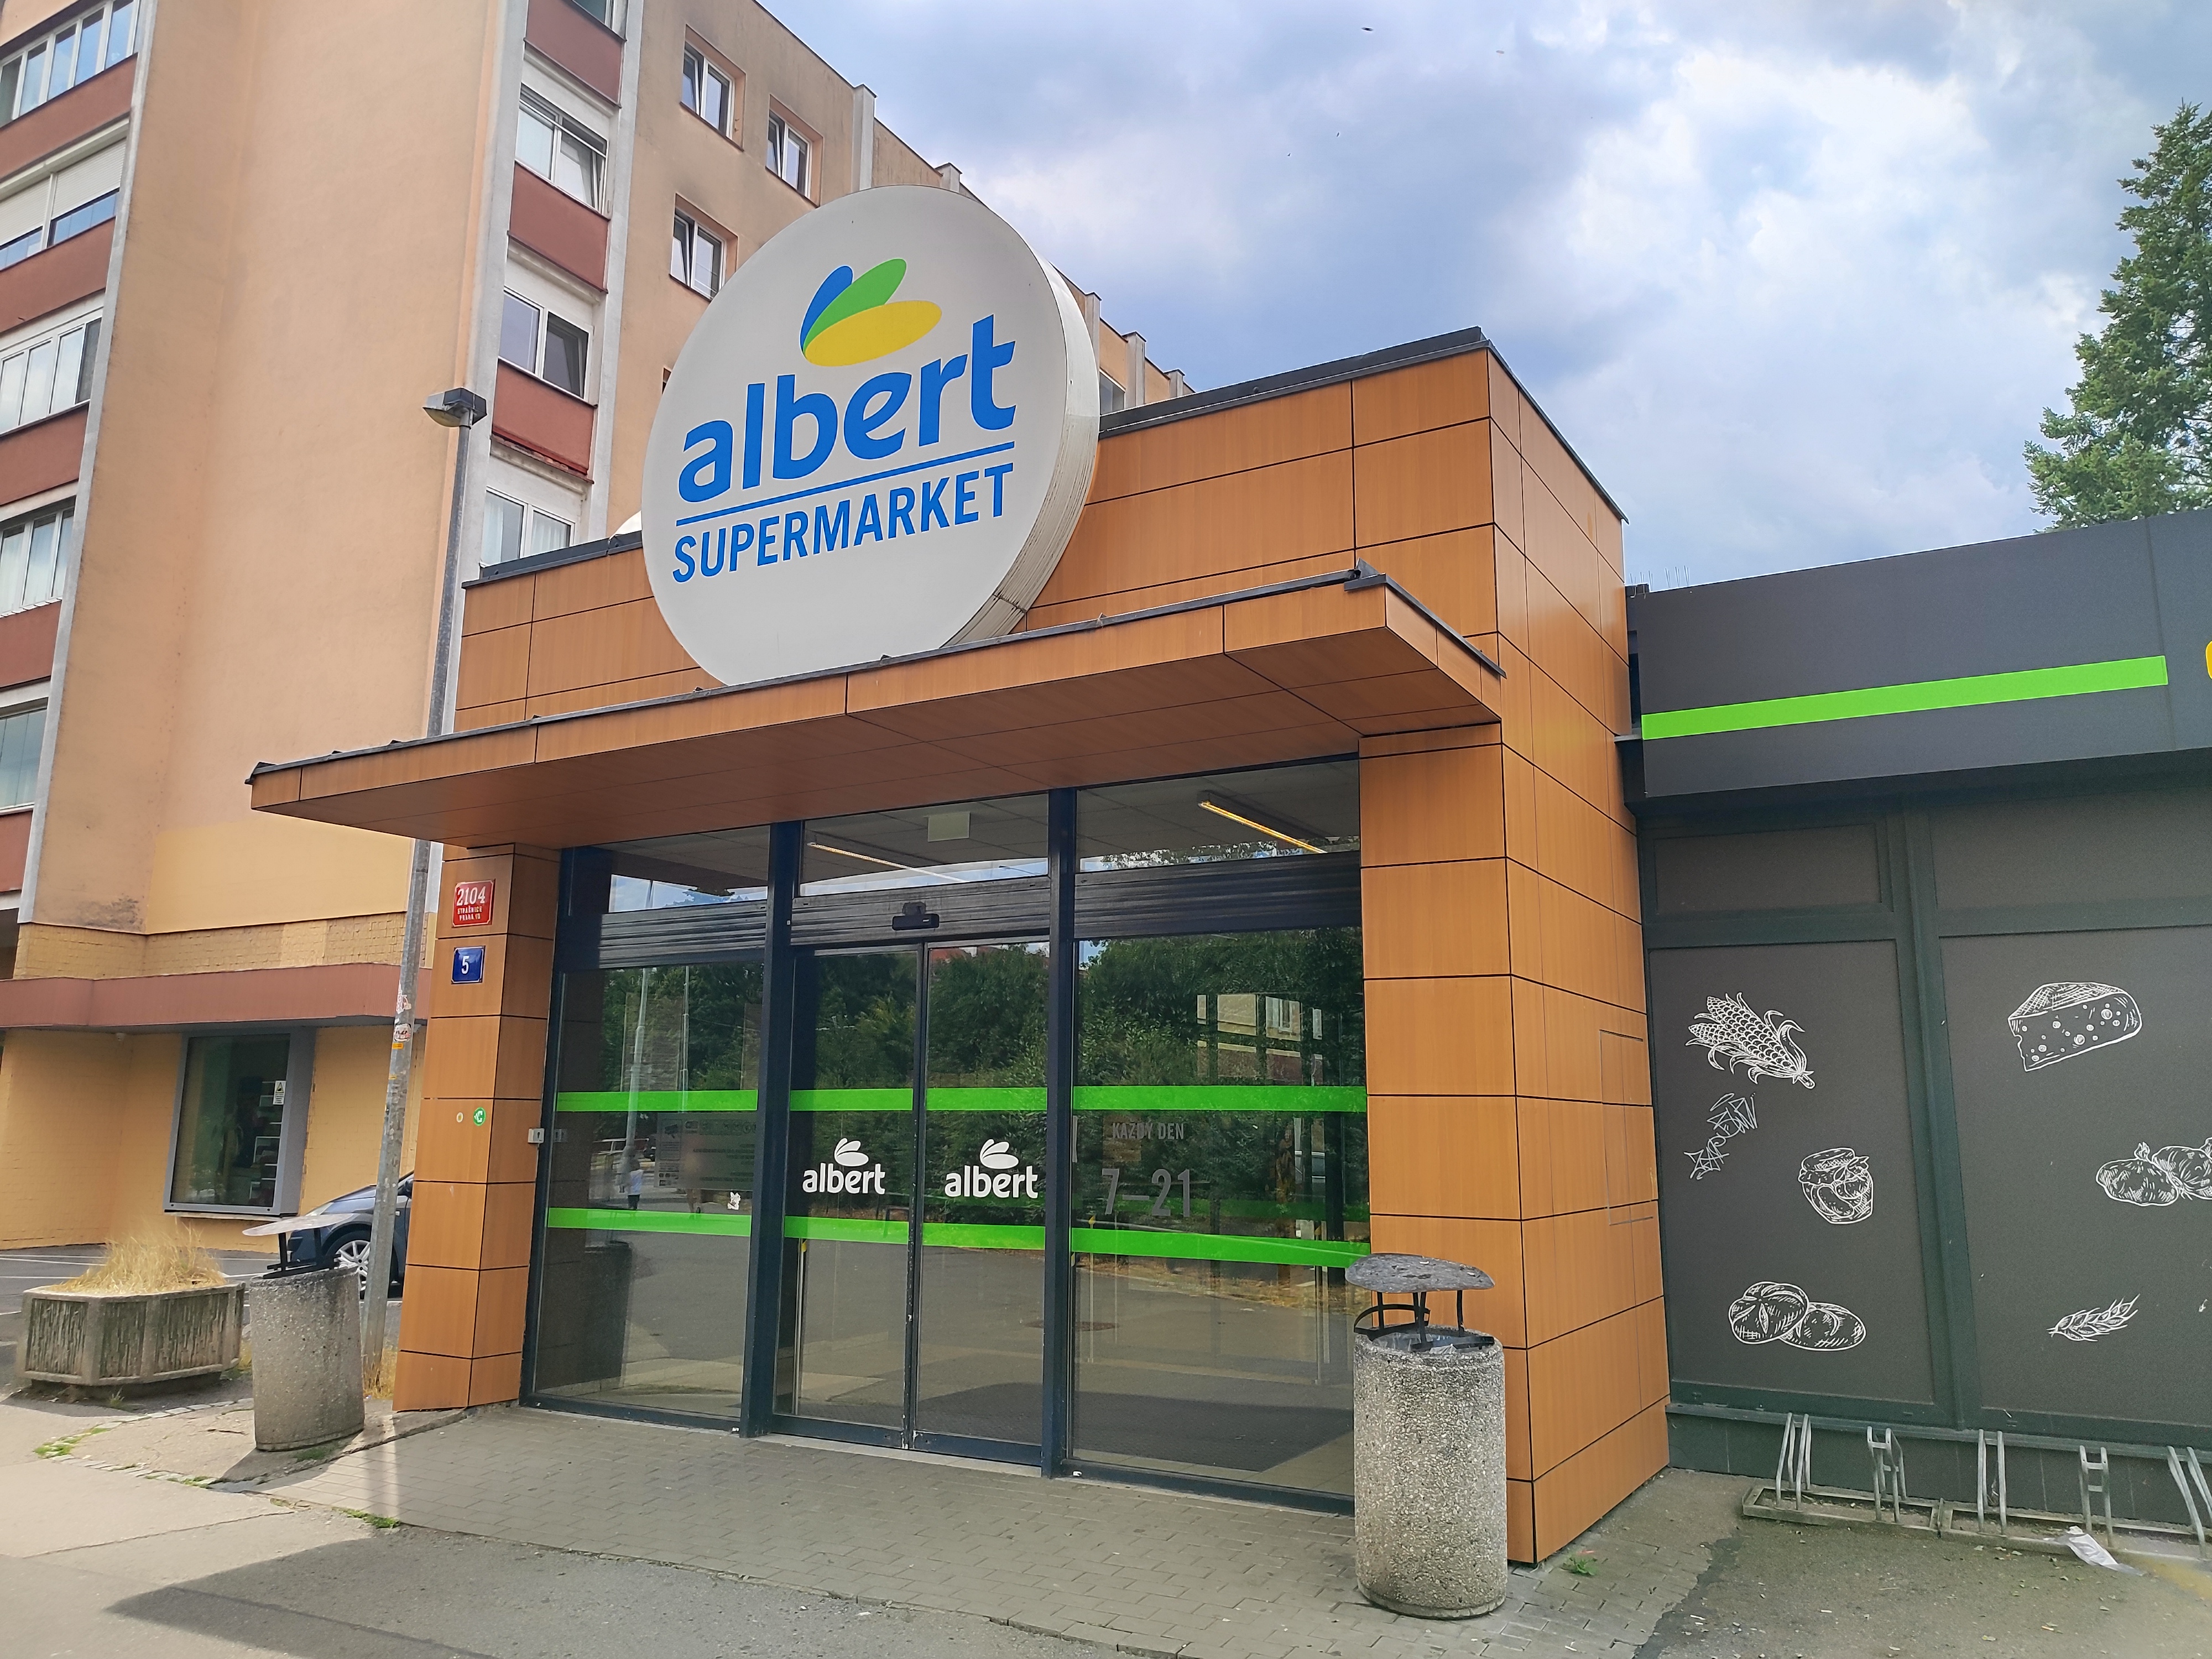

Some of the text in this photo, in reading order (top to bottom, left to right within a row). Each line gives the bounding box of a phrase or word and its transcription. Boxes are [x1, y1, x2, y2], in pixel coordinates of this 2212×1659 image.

[679, 315, 1016, 503] albert
[672, 462, 1014, 583] SUPERMARKET
[456, 886, 486, 906] 2104
[461, 955, 470, 974] 5
[1158, 1122, 1184, 1140] DEN
[802, 1162, 886, 1195] albert
[945, 1165, 1039, 1199] albert
